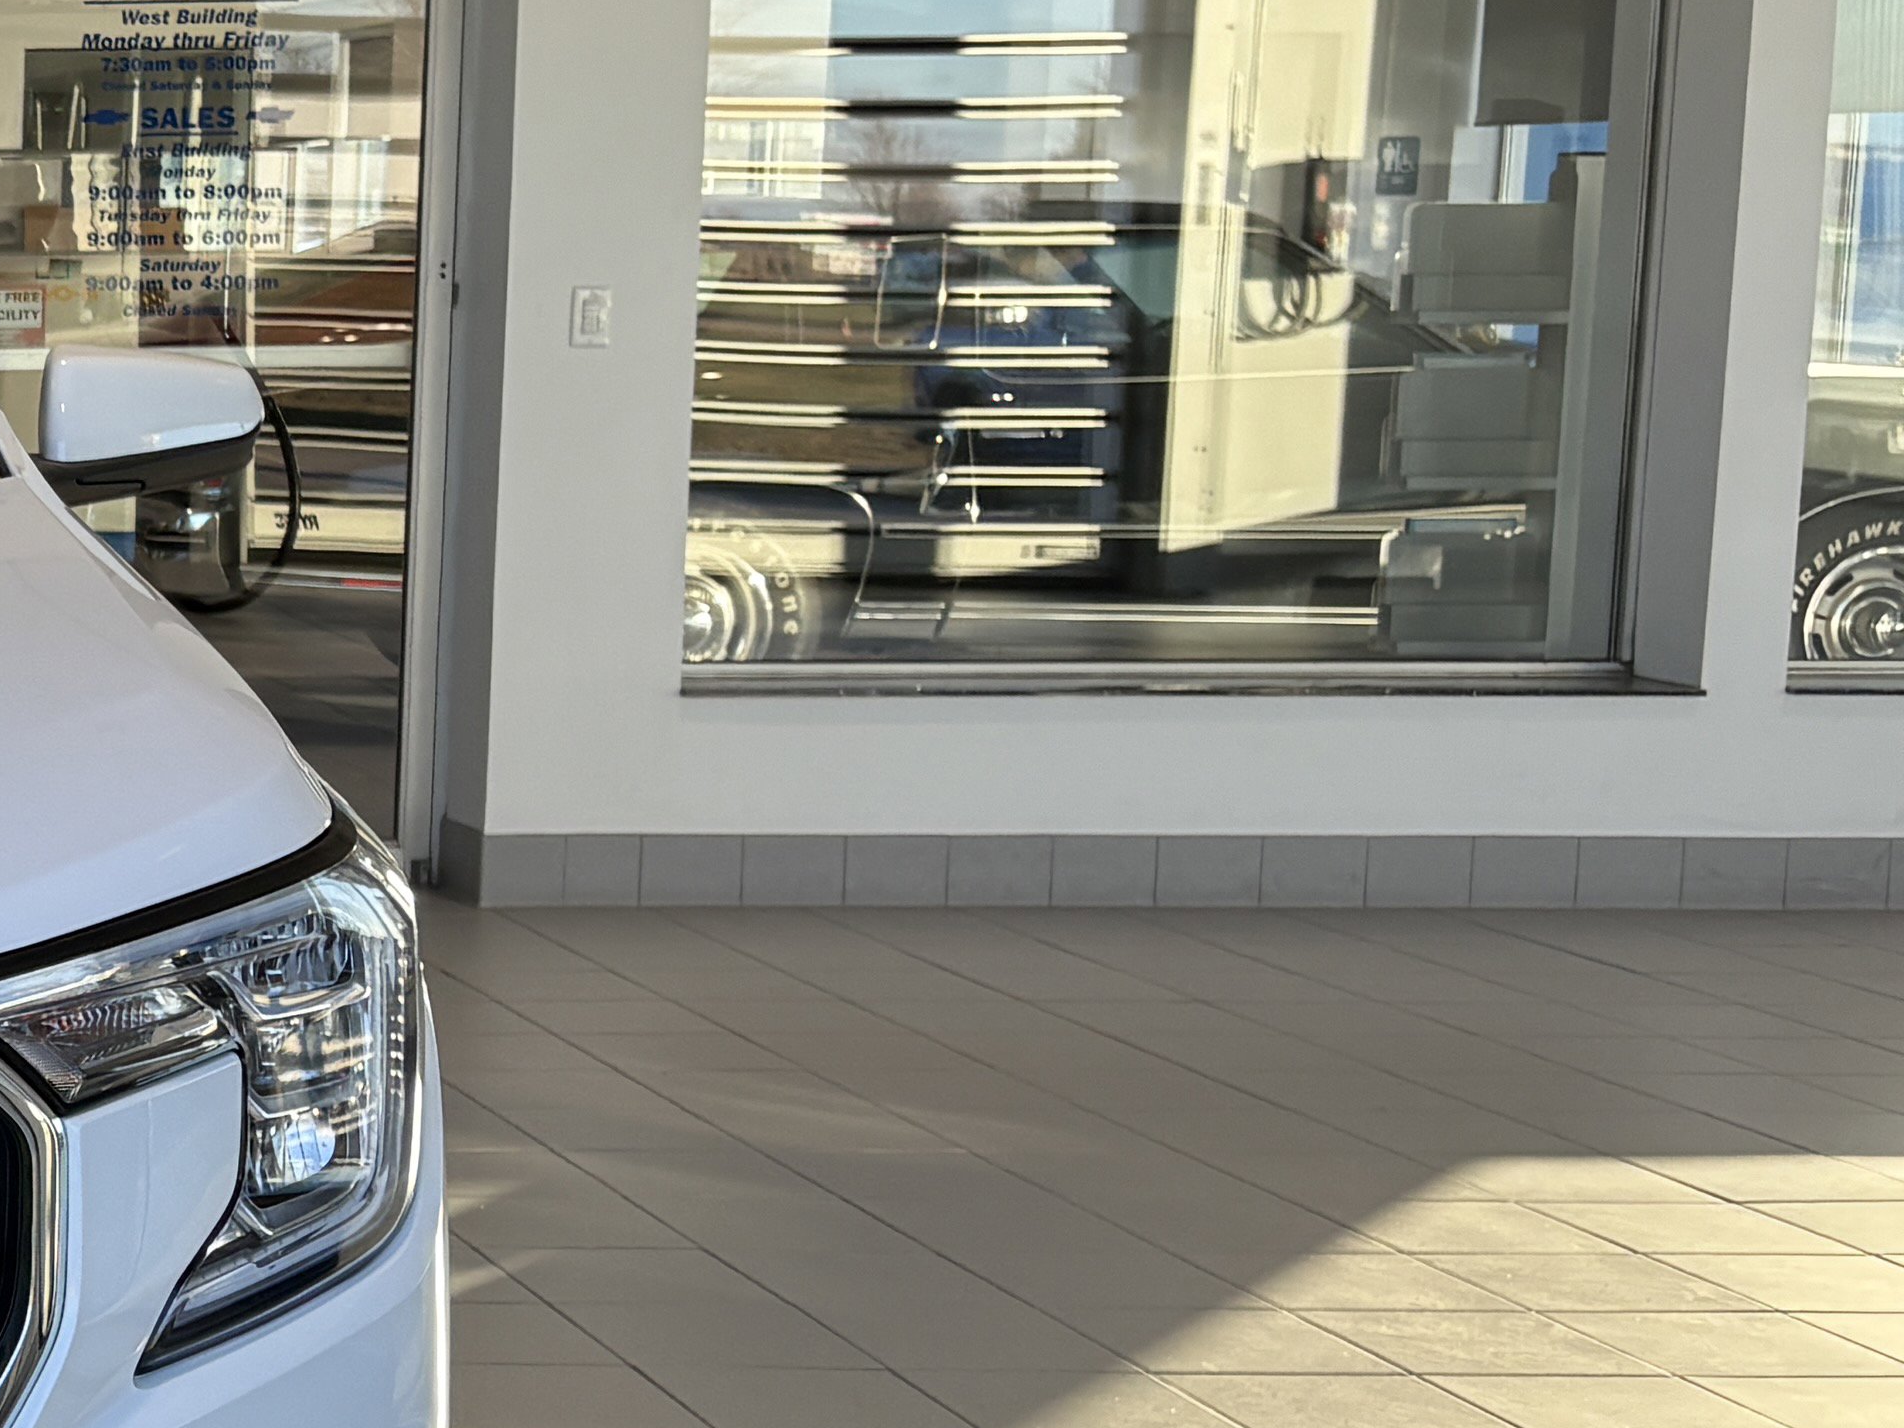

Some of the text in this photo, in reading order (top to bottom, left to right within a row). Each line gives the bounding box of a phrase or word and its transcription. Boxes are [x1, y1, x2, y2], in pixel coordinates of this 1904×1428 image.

[121, 8, 258, 27] West Building
[81, 31, 290, 51] Monday thru Friday
[100, 56, 172, 73] 7:30am
[178, 56, 198, 72] to
[140, 107, 236, 130] SALES
[149, 165, 216, 180] onday
[174, 185, 195, 201] to
[172, 230, 194, 245] to
[202, 230, 282, 246] 6:00pm
[139, 258, 222, 274] Saturday
[171, 275, 193, 291] to
